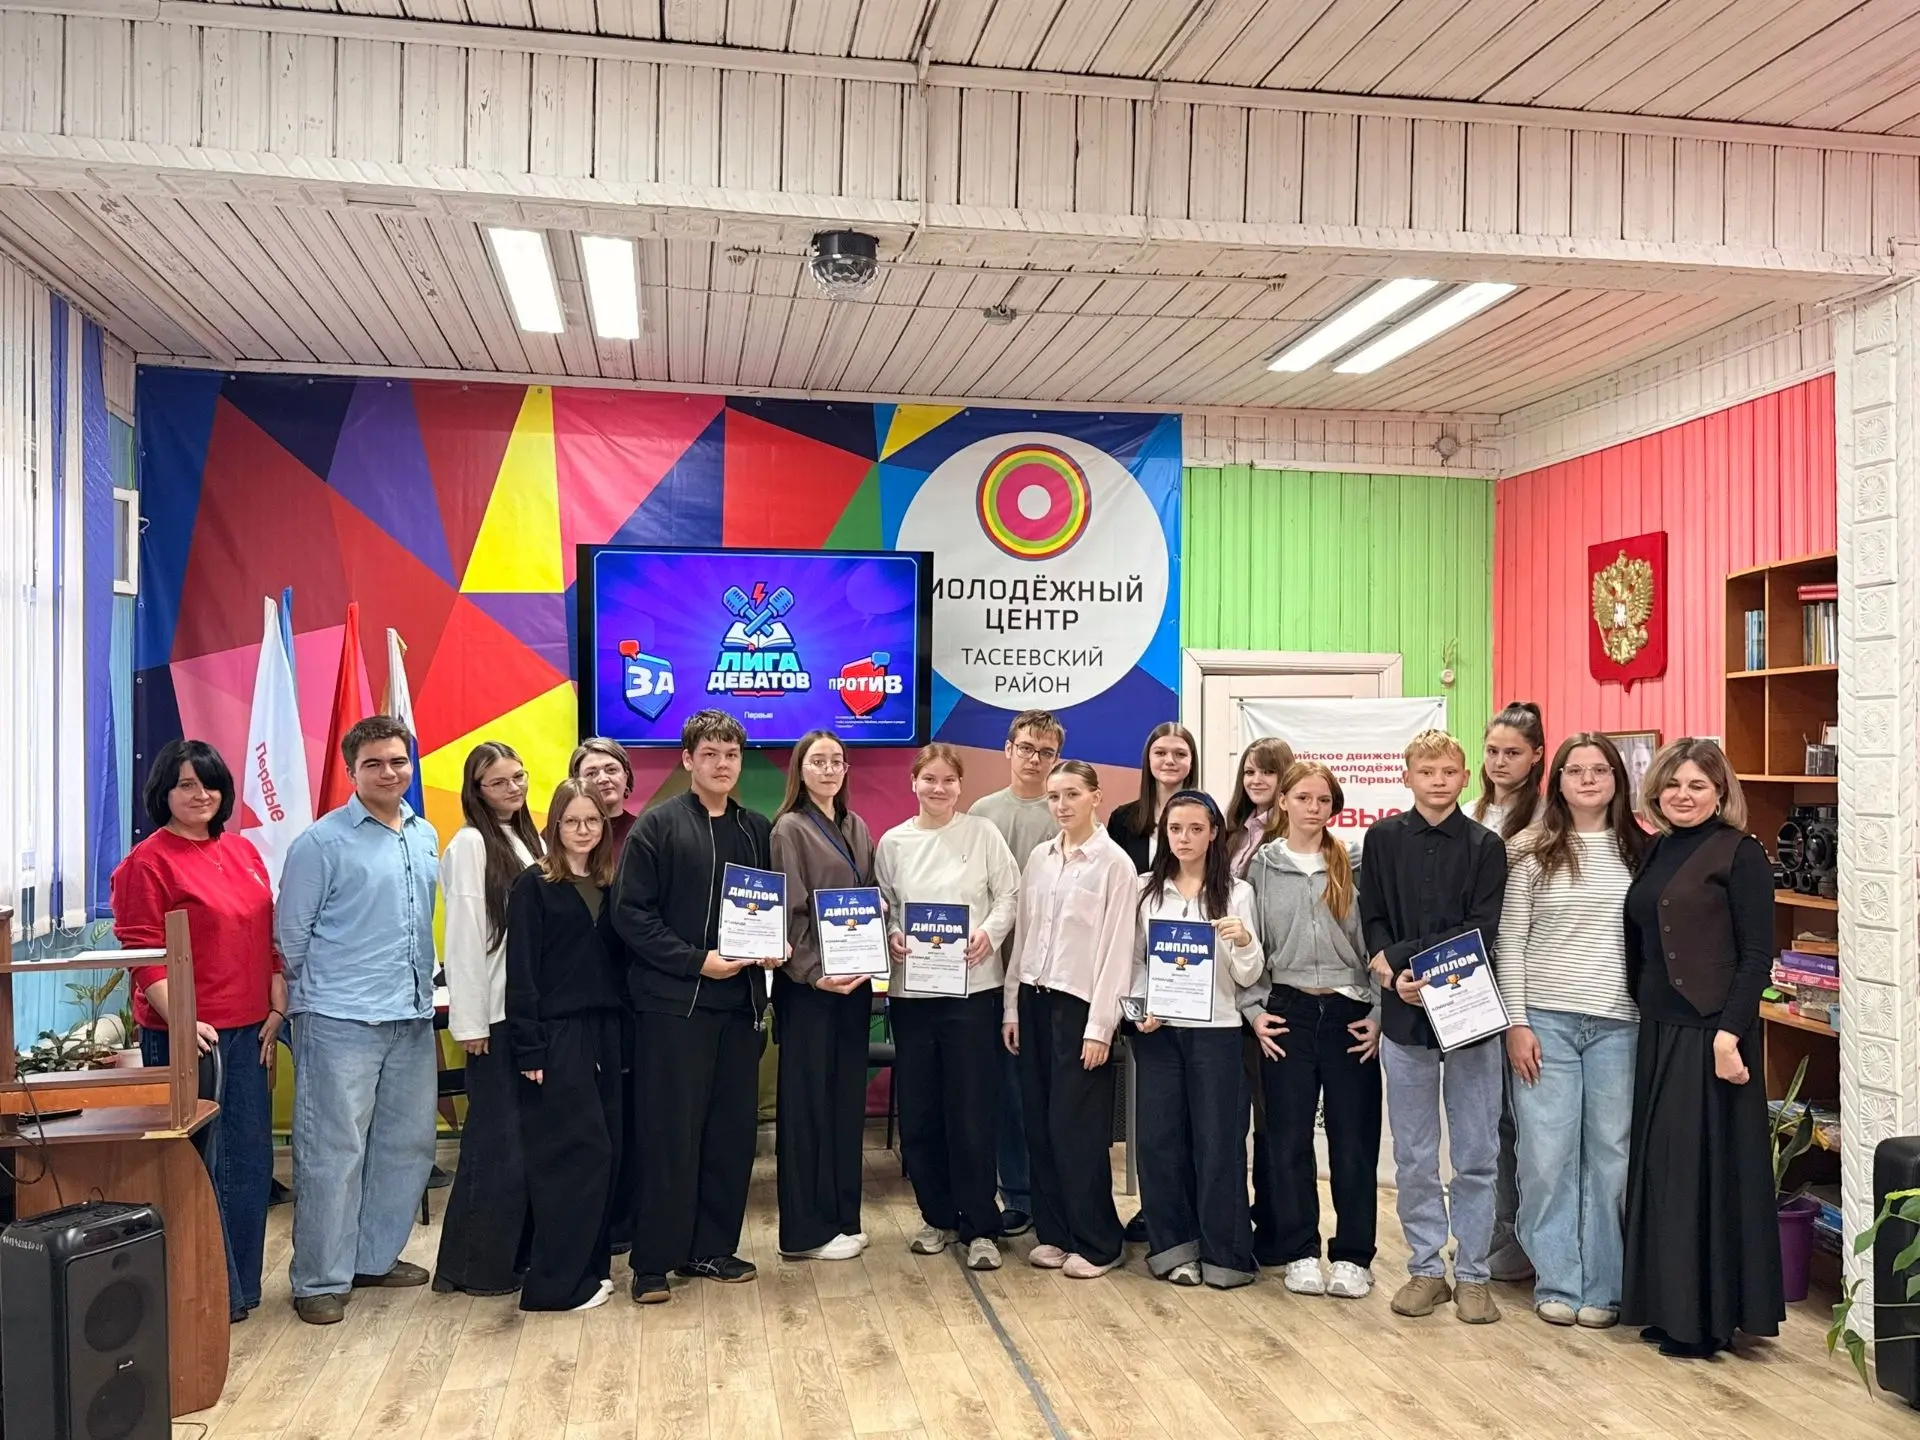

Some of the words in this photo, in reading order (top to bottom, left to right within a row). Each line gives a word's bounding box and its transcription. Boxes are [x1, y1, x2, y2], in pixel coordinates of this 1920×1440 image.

[985, 608, 1079, 634] ЦЕНТР
[717, 651, 800, 672] ЛИГА
[961, 646, 1104, 667] ТАСЕЕВСКИЙ
[626, 666, 675, 697] ЗА
[707, 671, 811, 692] ДЕБАТОВ
[829, 674, 903, 695] ПРОТИВ
[995, 672, 1070, 693] РАЙОН
[744, 711, 773, 720] Первые
[1293, 751, 1343, 760] ийское
[1330, 763, 1403, 773] молодёжи
[1350, 775, 1404, 785] Первых
[728, 886, 779, 902] ДИПЛОМ
[824, 905, 876, 917] ДИПЛОМ
[910, 922, 963, 934] ДИПЛОМ
[1154, 941, 1209, 955] ДИПЛОМ
[1422, 952, 1479, 979] ДИПЛОМ
